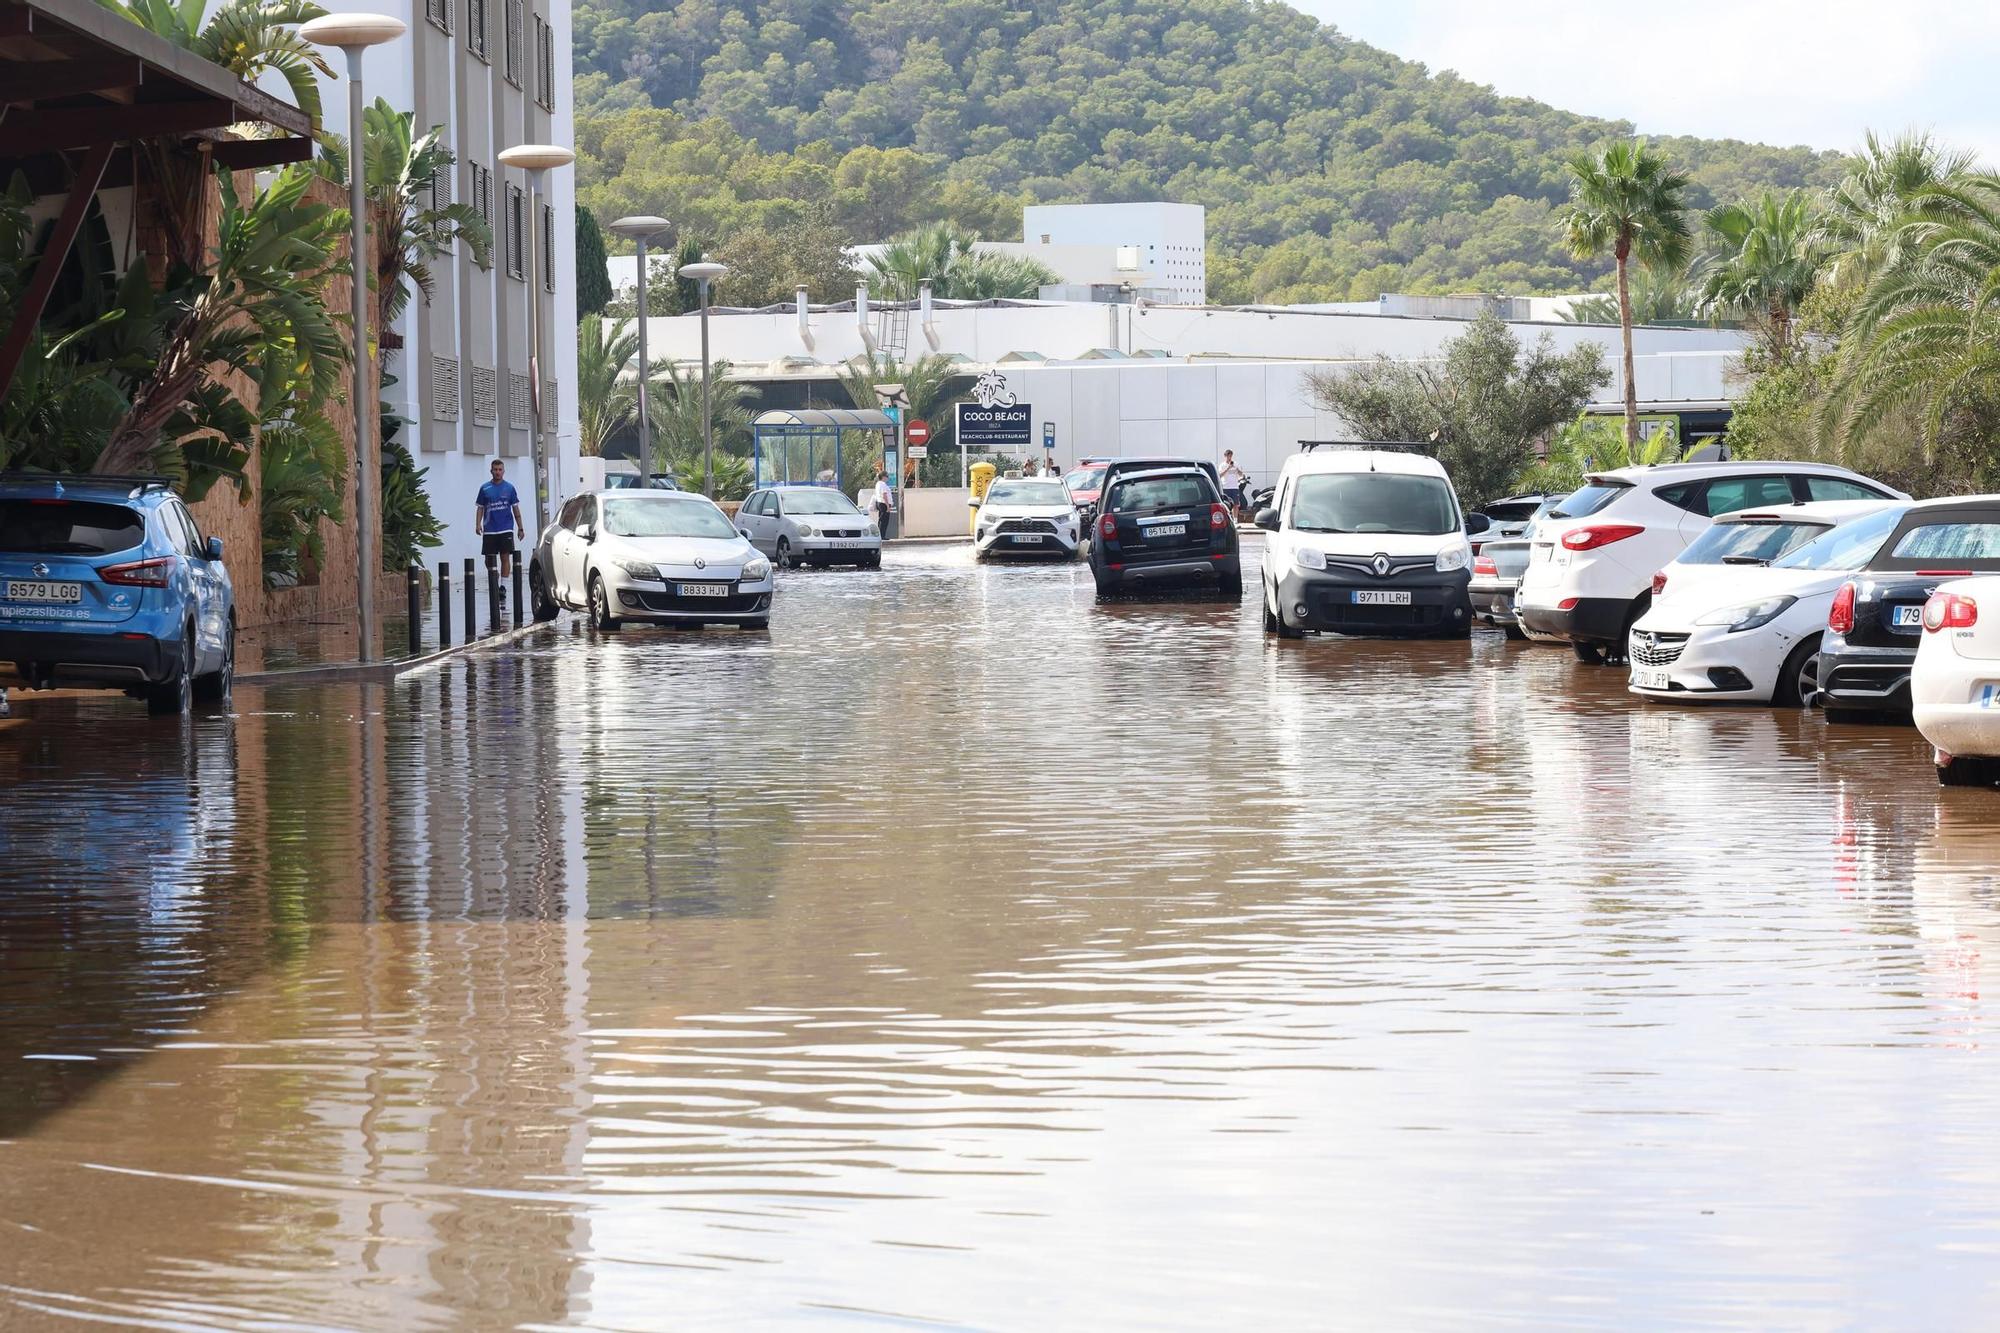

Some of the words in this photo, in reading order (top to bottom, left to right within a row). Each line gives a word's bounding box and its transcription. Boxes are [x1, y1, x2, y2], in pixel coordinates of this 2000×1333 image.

[964, 412, 993, 421] COCO
[994, 412, 1026, 421] BEACH
[1148, 526, 1167, 536] 8514
[10, 583, 46, 598] 6579
[51, 585, 78, 599] LGG
[683, 586, 707, 595] 8833
[709, 586, 726, 595] HJV
[1360, 592, 1385, 603] 9711
[1389, 592, 1409, 603] LRH
